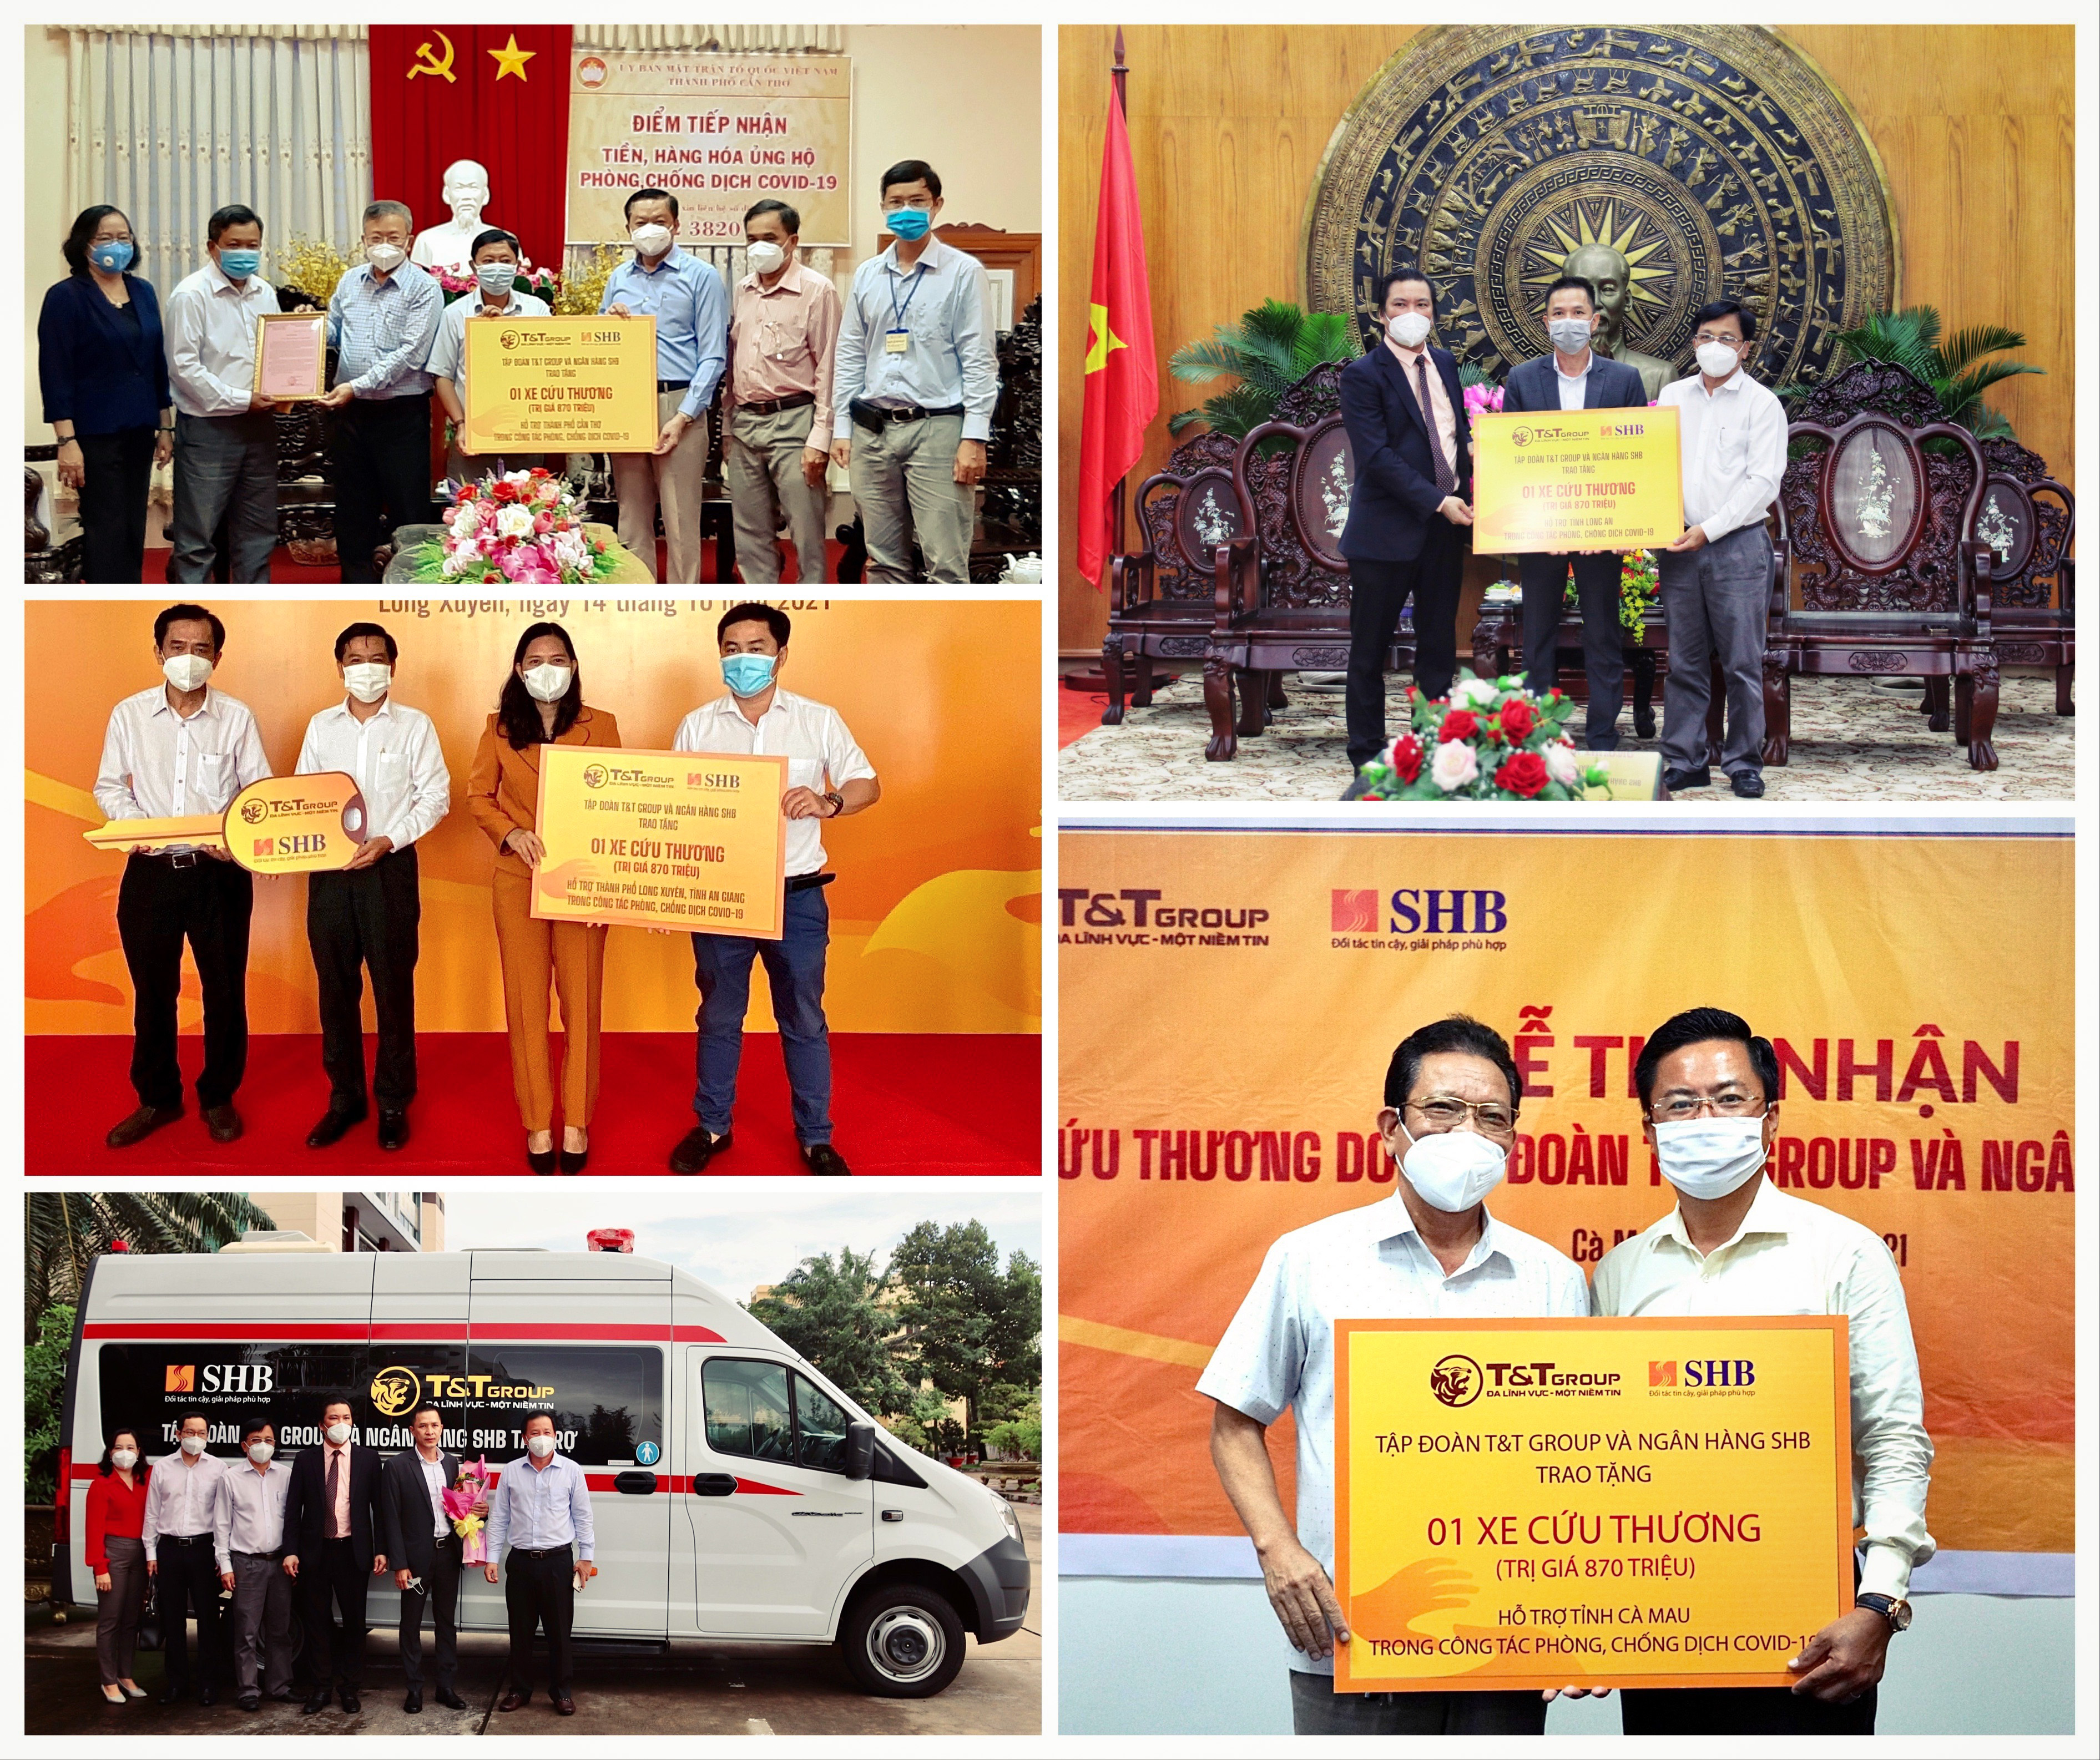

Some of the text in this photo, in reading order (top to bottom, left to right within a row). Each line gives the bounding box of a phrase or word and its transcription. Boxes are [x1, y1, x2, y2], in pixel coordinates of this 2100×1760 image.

[632, 106, 787, 138] ĐIỂM TIẾP NHẬN
[602, 143, 648, 166] TIỀN,
[655, 145, 702, 165] HÀNG
[708, 146, 744, 165] HÓA
[791, 148, 815, 169] HỘ
[711, 174, 751, 192] DỊCH
[758, 175, 837, 191] COVID-19
[689, 221, 740, 236] 3820
[594, 331, 621, 342] SHB
[510, 385, 613, 401] 01 XE CỨU THƯƠNG
[1615, 424, 1644, 436] SHB
[1522, 481, 1635, 499] 01 XE CỨU THƯƠNG
[1586, 517, 1603, 526] LONG
[1604, 517, 1613, 526] AN
[704, 773, 740, 788] SHB
[279, 834, 326, 854] SHB
[591, 838, 725, 863] 01 XE CỨU THƯƠNG
[613, 860, 700, 880] (TRỊ GIÁ 870 TRIỆU)
[596, 879, 620, 894] THÀNH
[639, 884, 659, 897] LONG
[708, 890, 720, 902] AN
[721, 891, 745, 904] GIANG
[1390, 889, 1507, 934] SHB
[1075, 932, 1269, 948] LĨNH VỰC MỘT NIỀM TIN
[1332, 938, 1507, 952] Đối tác tin cậy, giải pháp phù hợp
[1775, 1024, 2019, 1119] NHẬN
[1058, 1117, 1119, 1181] ỨU
[1133, 1129, 1321, 1183] THƯƠNG
[1507, 1124, 1628, 1186] ĐOÀN
[1910, 1129, 1967, 1191] VÀ
[1981, 1130, 2076, 1193] NGÂ
[1572, 1228, 1604, 1262] Cà
[201, 1364, 273, 1393] SHB
[1684, 1360, 1755, 1387] SHB
[164, 1395, 271, 1405] Đối tác tin cậy, giải pháp phù hợp
[441, 1399, 463, 1408] LĨNH
[466, 1400, 485, 1409] VỰC
[491, 1400, 511, 1410] MỘT
[513, 1400, 537, 1409] NIỀM
[1503, 1388, 1526, 1397] LĨNH
[1528, 1389, 1549, 1398] VỰC
[1555, 1389, 1577, 1398] MỘT
[1579, 1388, 1603, 1397] NIỀM
[161, 1420, 179, 1445] TẬ
[207, 1421, 240, 1444] OÀN
[281, 1425, 324, 1446] GROU
[366, 1424, 414, 1447] NGÂN
[472, 1429, 507, 1449] SHB
[555, 1430, 578, 1453] RỢ
[1375, 1428, 1811, 1458] TẬP ĐOÀN T&T GROUP VÀ NGÂN HÀNG SHB
[1536, 1461, 1652, 1487] TRAO TẶNG
[1427, 1509, 1761, 1546] 01 XE CỨU THƯƠNG
[1496, 1554, 1696, 1582] (TRỊ GIÁ 870 TRIỆU)
[1498, 1603, 1690, 1629] HỖ TRỢ TỈNH CÀ MAU
[1369, 1639, 1435, 1657] TRONG
[1438, 1634, 1493, 1657] CÔNG
[1494, 1634, 1531, 1656] TÁC
[1536, 1633, 1607, 1658] PHÒNG,
[1612, 1631, 1680, 1654] CHỐNG
[1685, 1636, 1729, 1657] DỊCH
